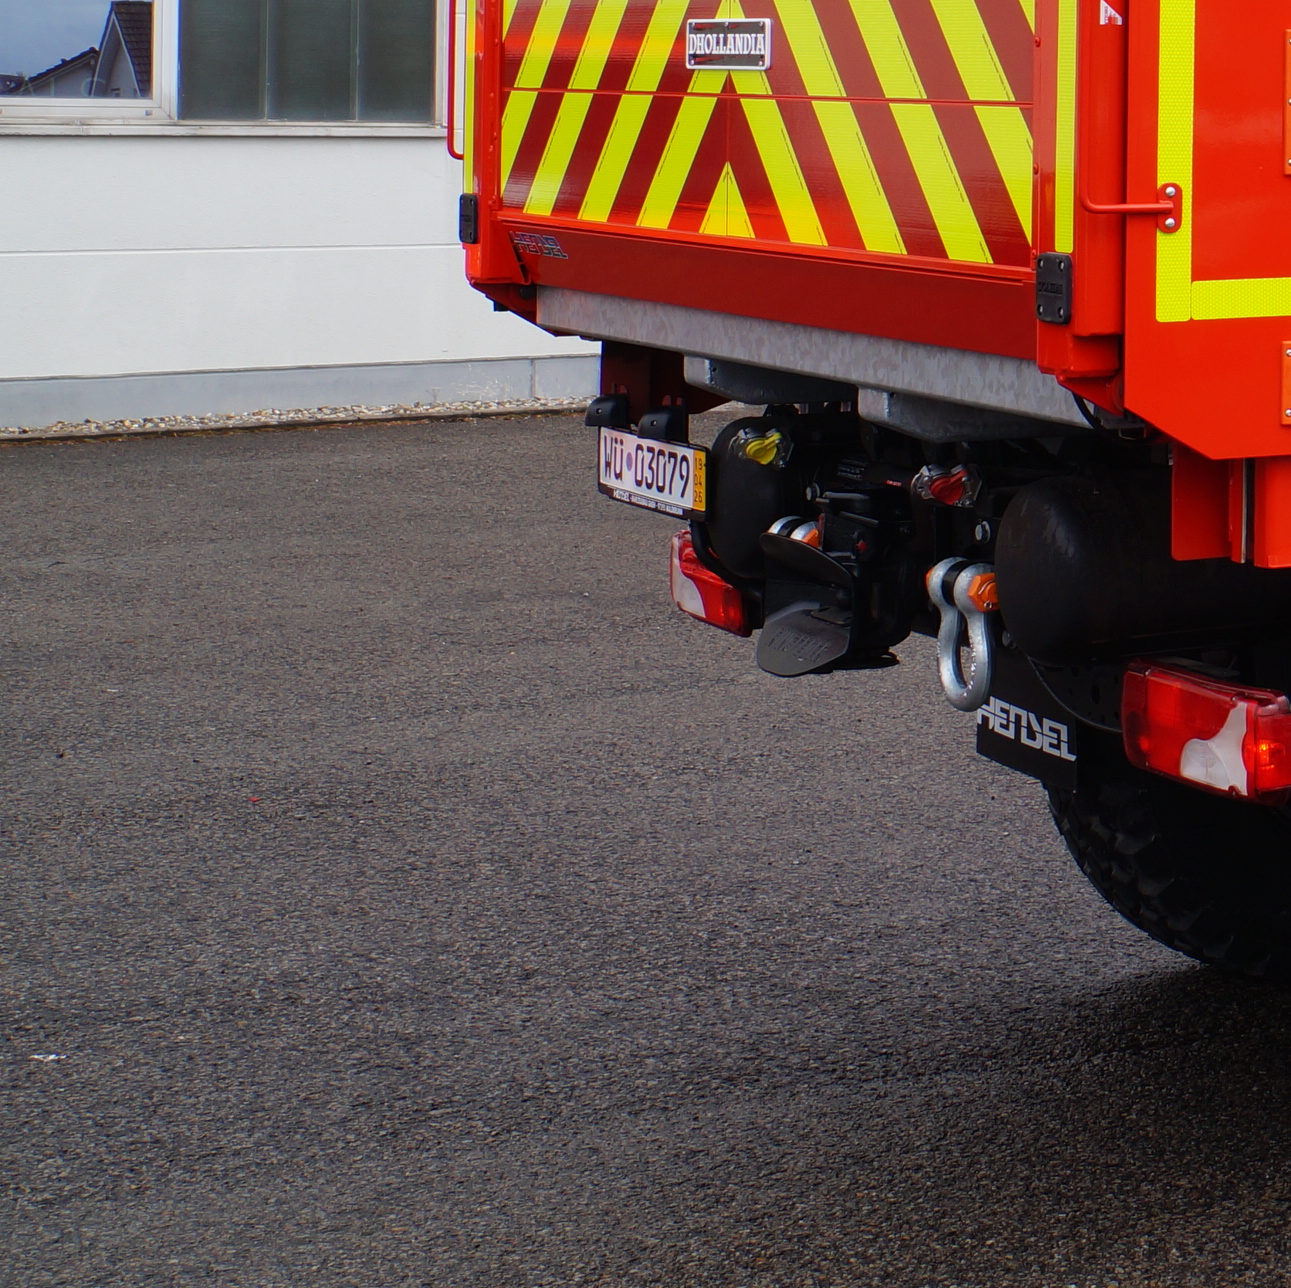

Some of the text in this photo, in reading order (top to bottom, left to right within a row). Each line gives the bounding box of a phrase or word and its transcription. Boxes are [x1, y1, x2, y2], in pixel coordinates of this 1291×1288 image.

[688, 33, 765, 55] DHOLLANDIA
[604, 435, 690, 499] WÜ 03079
